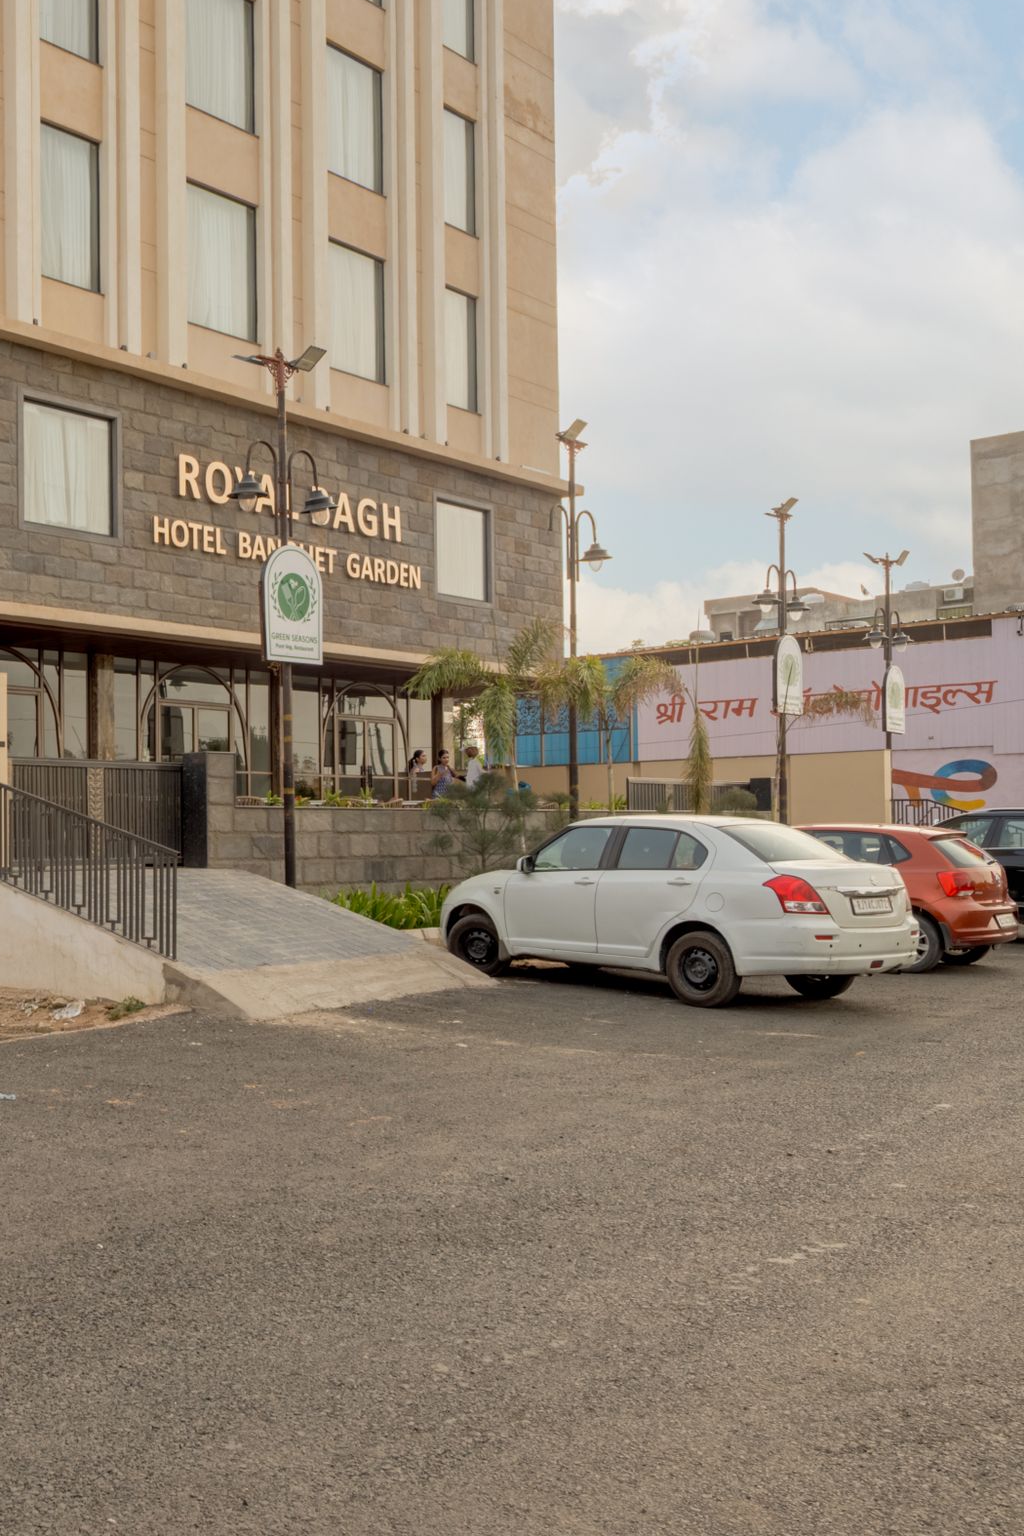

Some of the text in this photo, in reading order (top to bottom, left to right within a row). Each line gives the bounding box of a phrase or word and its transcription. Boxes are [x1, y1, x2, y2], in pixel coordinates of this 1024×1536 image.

[153, 515, 422, 590] HOTEL BANET GARDEN
[271, 632, 318, 644] GREEN SEASONS
[656, 694, 687, 725] श्री
[698, 698, 758, 721] राम
